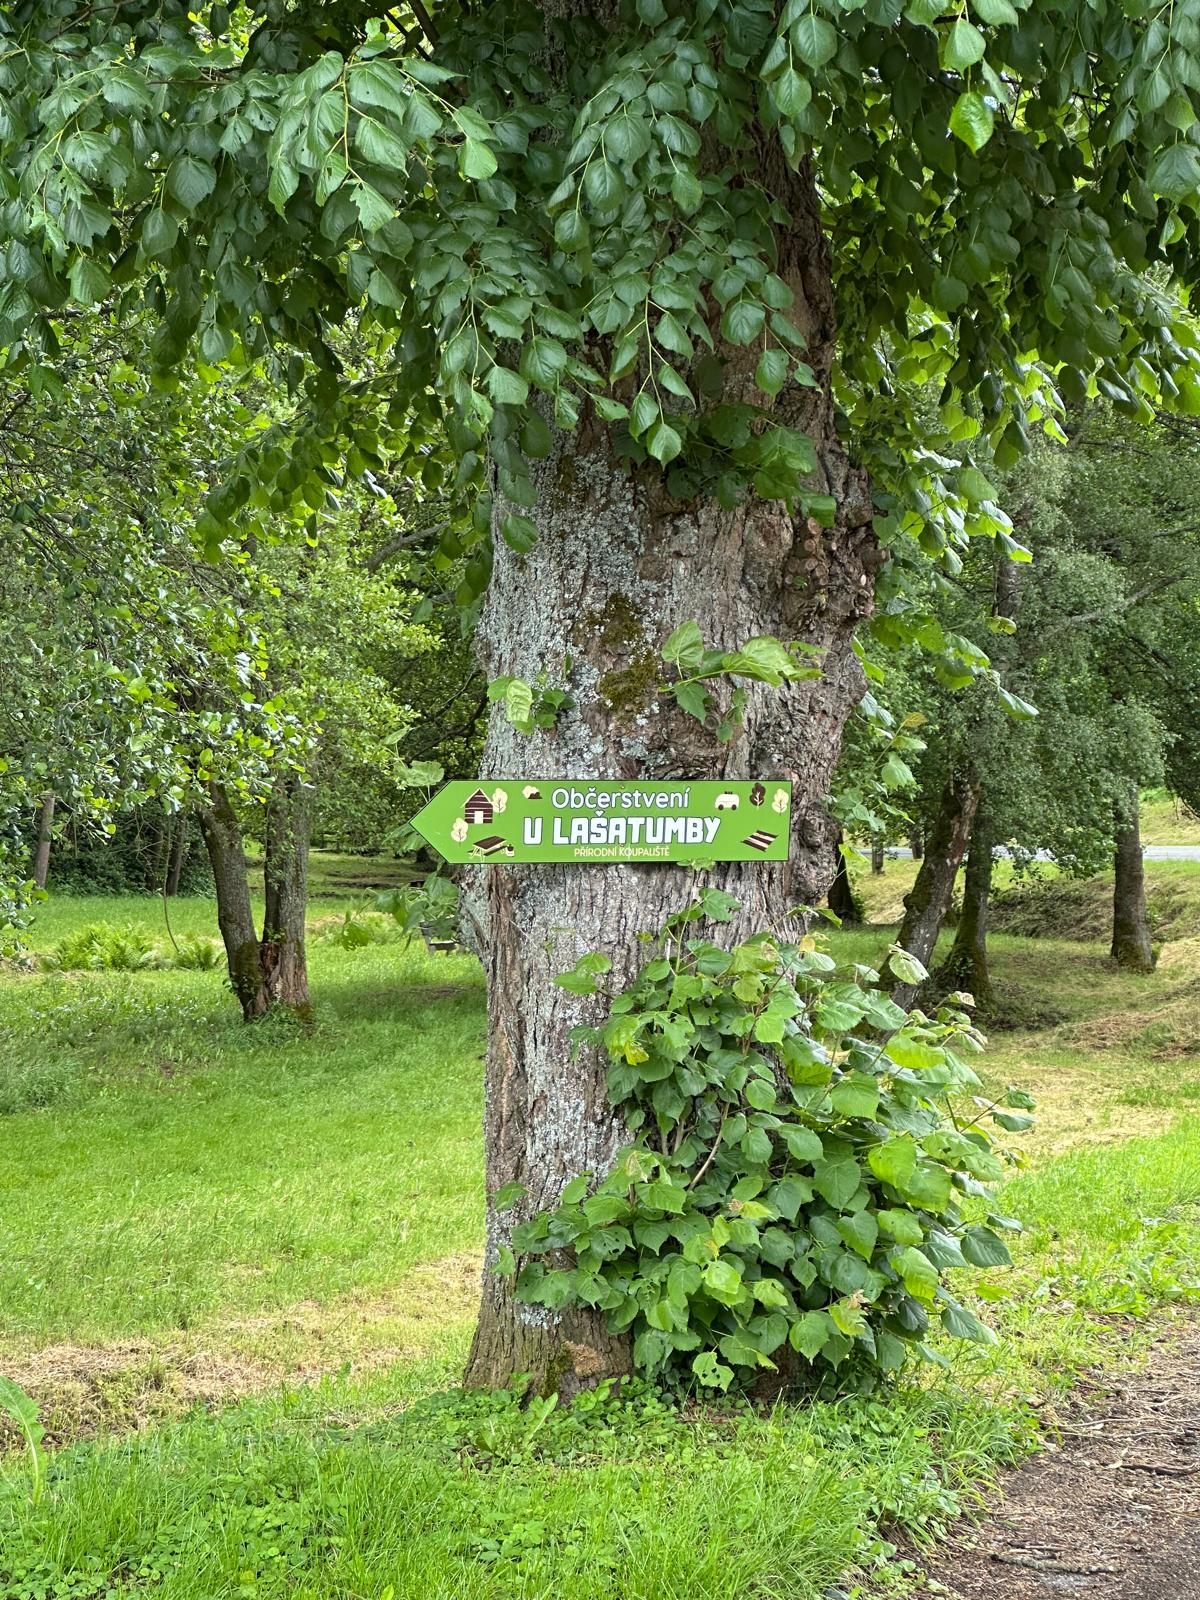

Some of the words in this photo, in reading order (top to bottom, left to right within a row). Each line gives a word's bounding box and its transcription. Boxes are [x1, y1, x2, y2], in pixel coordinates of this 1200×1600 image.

[552, 787, 691, 809] Občerstvení
[523, 816, 543, 845] U
[553, 810, 721, 845] LAŠATUMBY
[574, 845, 617, 857] PŘÍRODNÍ
[619, 845, 670, 857] KOUPALIŠTĚ
